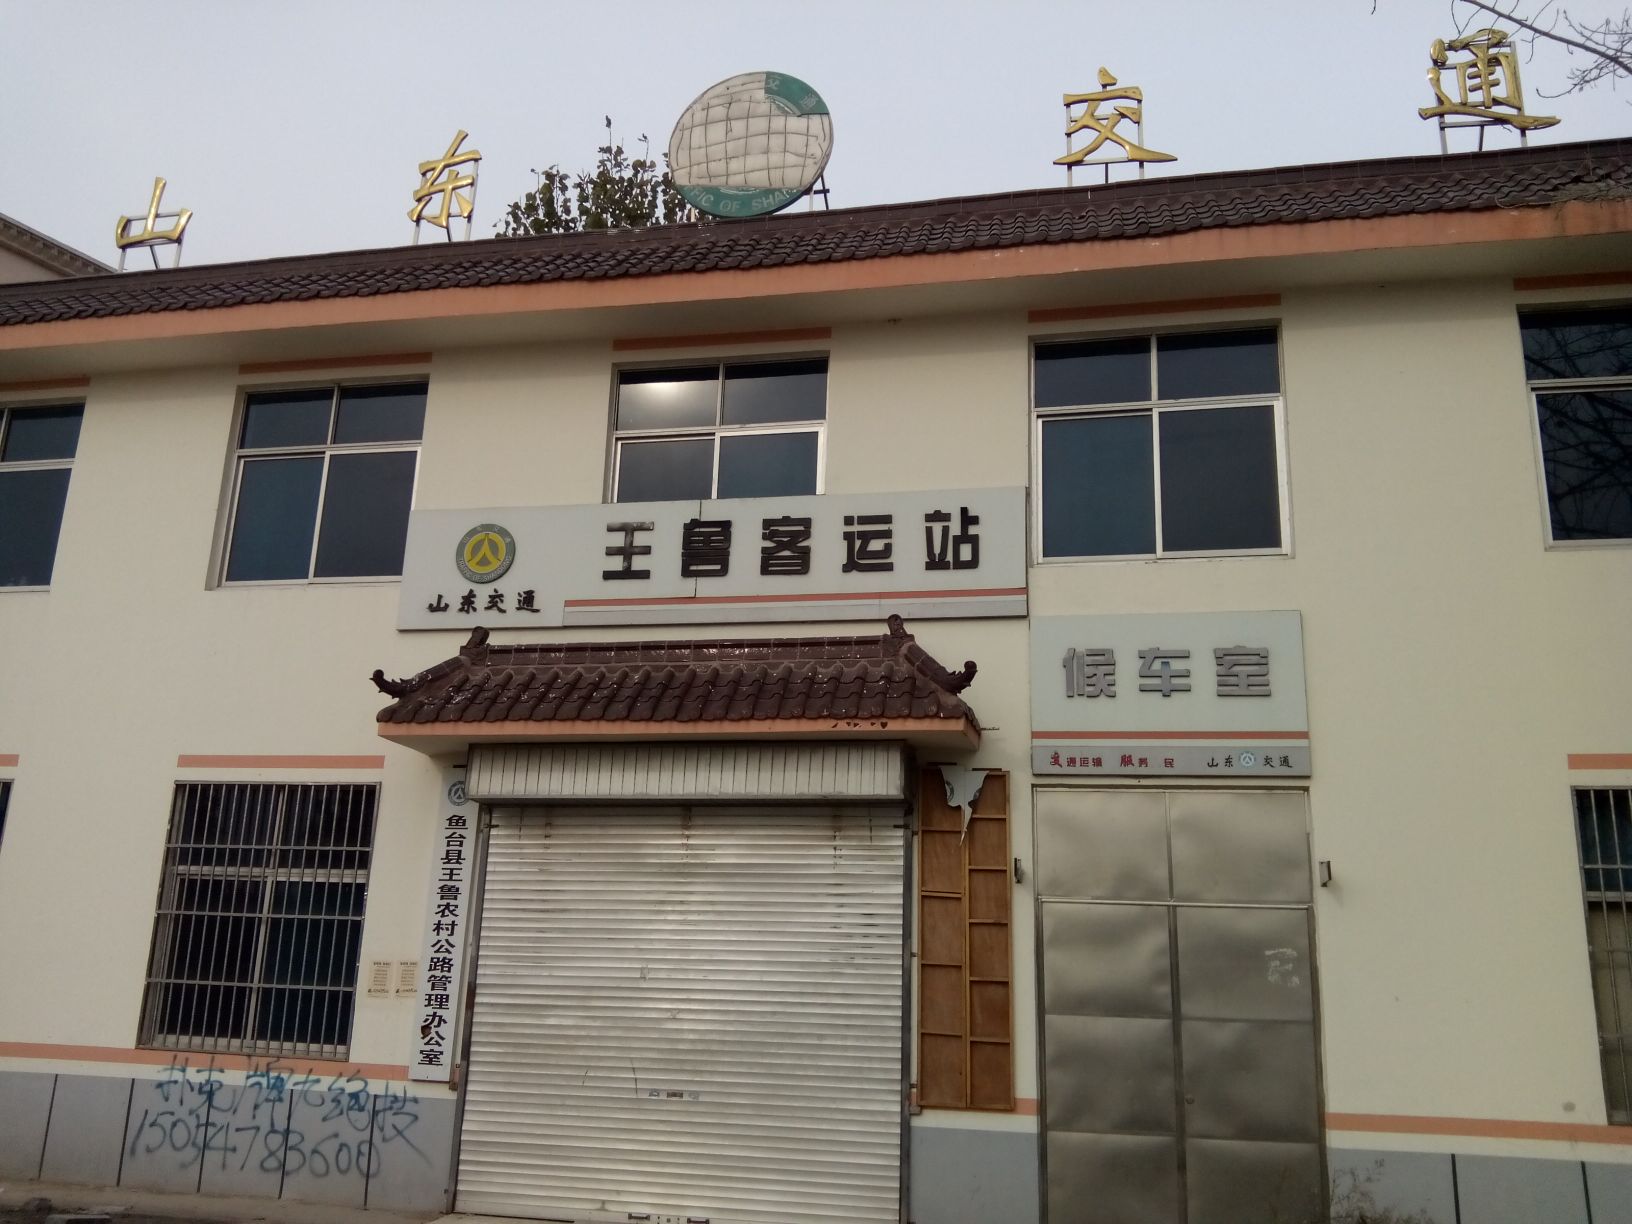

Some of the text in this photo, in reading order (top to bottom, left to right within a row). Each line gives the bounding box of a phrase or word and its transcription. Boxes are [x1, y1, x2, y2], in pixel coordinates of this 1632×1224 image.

[602, 507, 979, 580] 王鲁客运站
[428, 588, 540, 614] 山东交通
[1062, 645, 1271, 697] 候车室
[418, 814, 468, 1066] 鱼台县王鲁农村公路管理办公室
